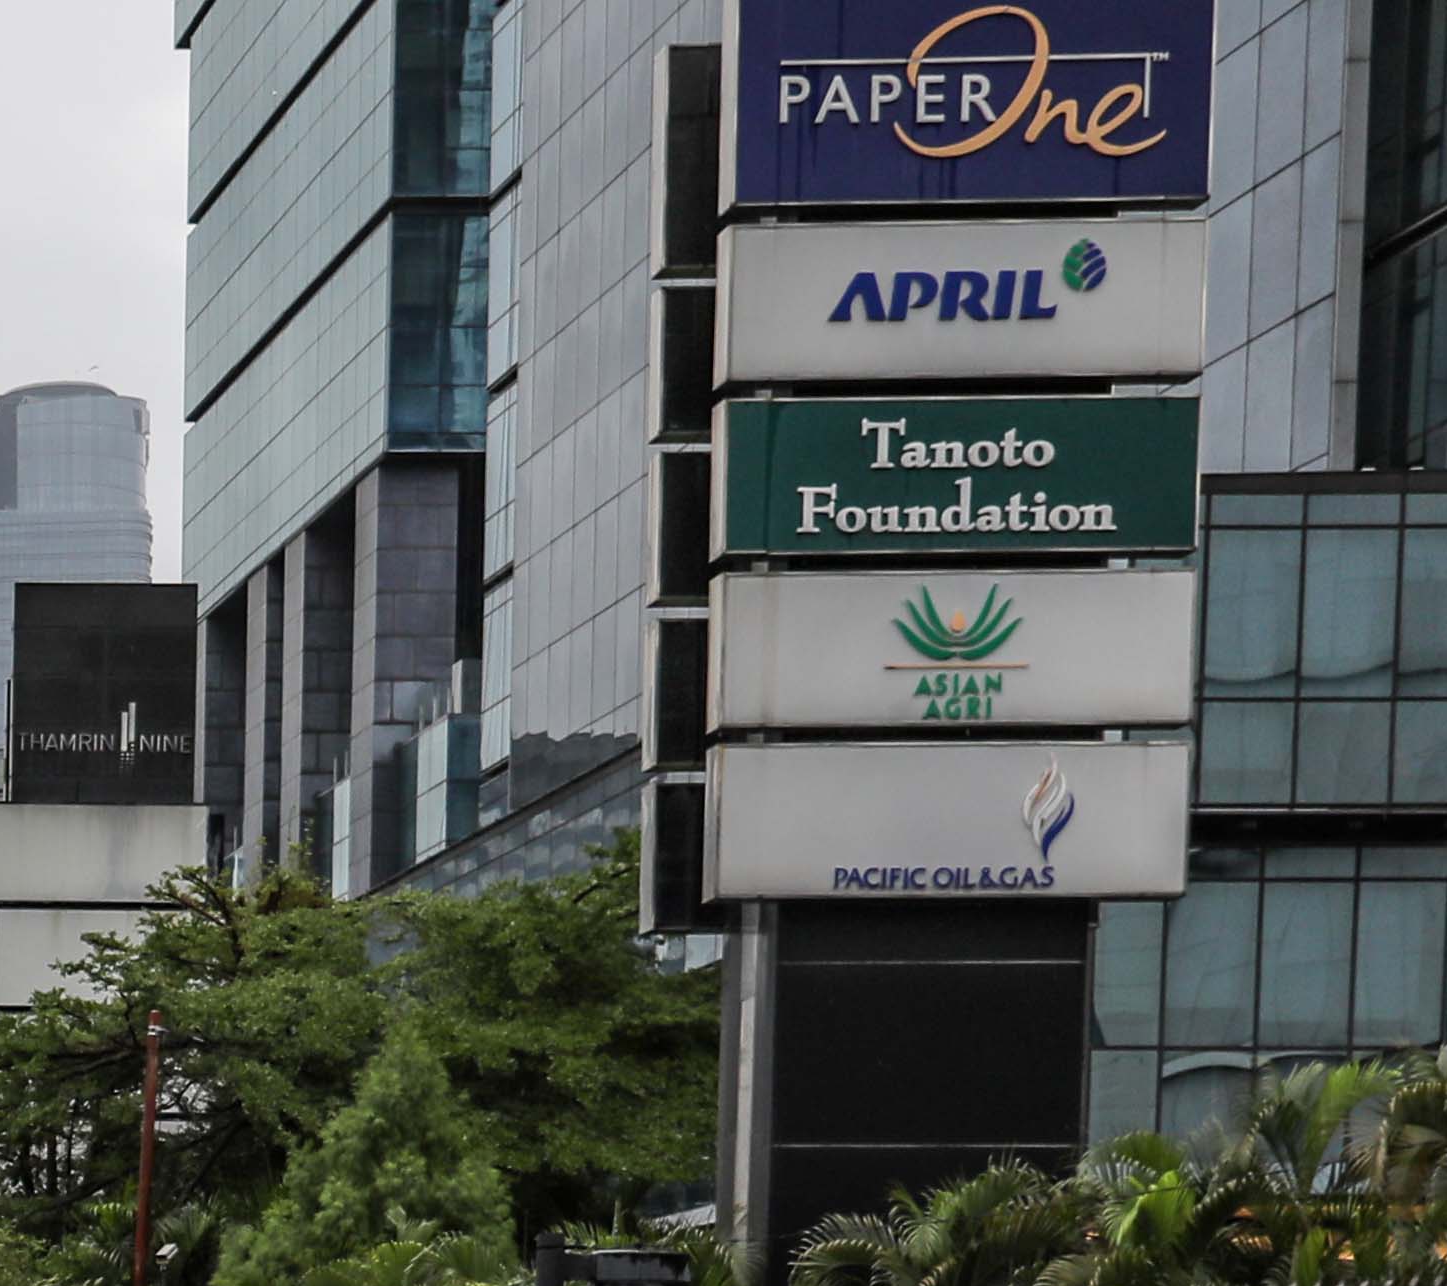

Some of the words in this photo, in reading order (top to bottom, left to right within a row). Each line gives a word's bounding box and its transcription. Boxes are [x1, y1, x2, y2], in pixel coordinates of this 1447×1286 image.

[778, 73, 997, 124] PAPER
[893, 4, 1168, 158] One
[828, 268, 1057, 323] APRIL
[861, 417, 1056, 470] Tanoto
[796, 479, 1117, 535] Foundation
[912, 672, 1003, 697] ASIAN
[921, 696, 993, 720] AGRI
[19, 731, 115, 753] THAMRIN
[138, 733, 193, 753] NINE
[832, 866, 928, 891] PACIFIC
